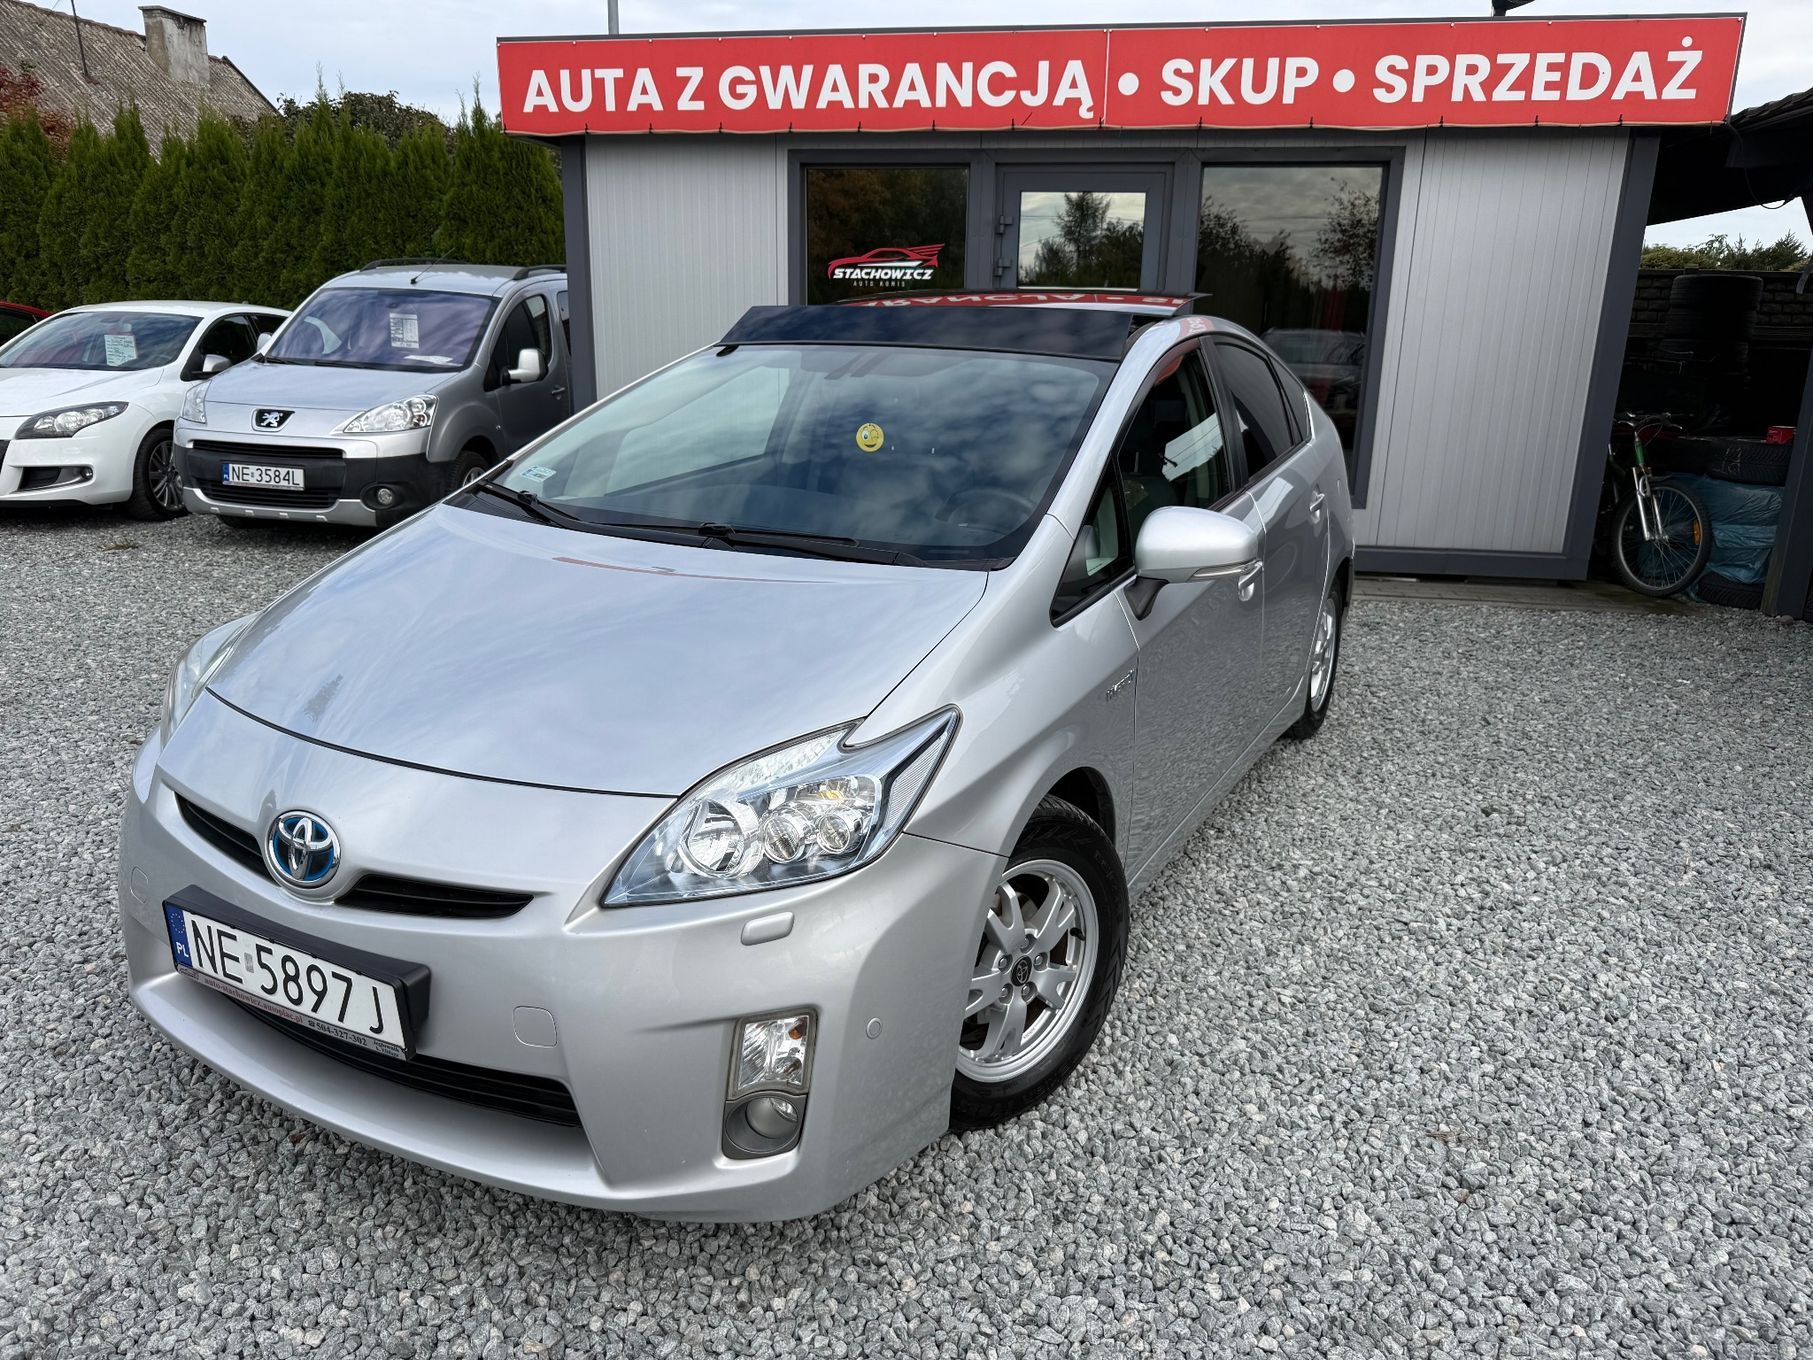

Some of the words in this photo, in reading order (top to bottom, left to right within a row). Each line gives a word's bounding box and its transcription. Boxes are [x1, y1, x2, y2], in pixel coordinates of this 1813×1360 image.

[523, 67, 664, 112] AUTA
[676, 66, 705, 111] Z
[718, 59, 1094, 119] GWARANCJĄ
[1160, 56, 1320, 106] SKUP
[1373, 36, 1703, 104] SPRZEDAŻ
[833, 268, 935, 280] STACHOWICZ
[231, 466, 250, 482] NE
[255, 467, 300, 486] 3584L
[175, 941, 189, 958] PL
[190, 919, 244, 984] NE
[255, 943, 385, 1034] 5897J
